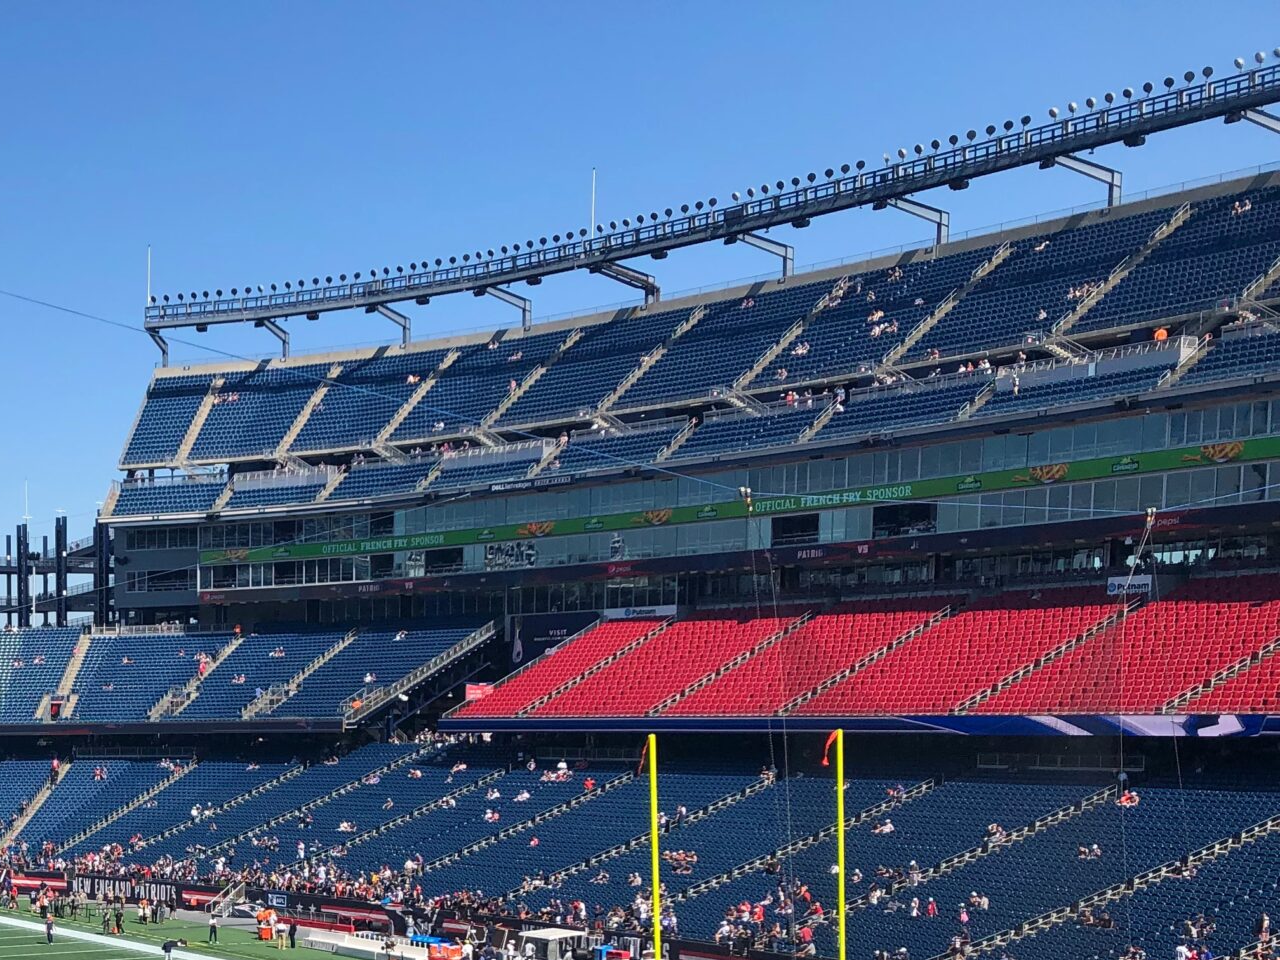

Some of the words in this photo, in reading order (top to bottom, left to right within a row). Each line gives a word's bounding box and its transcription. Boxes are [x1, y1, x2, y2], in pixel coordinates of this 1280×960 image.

[755, 500, 797, 513] OFFICIAL
[801, 496, 841, 509] FRENCH
[867, 486, 913, 500] SPONSOR
[1157, 516, 1180, 526] pepsi
[322, 544, 357, 553] OFFICIAL
[360, 541, 393, 551] FRENCH
[394, 539, 408, 548] FRY
[410, 535, 445, 546] SPONSOR
[72, 877, 91, 892] NEW
